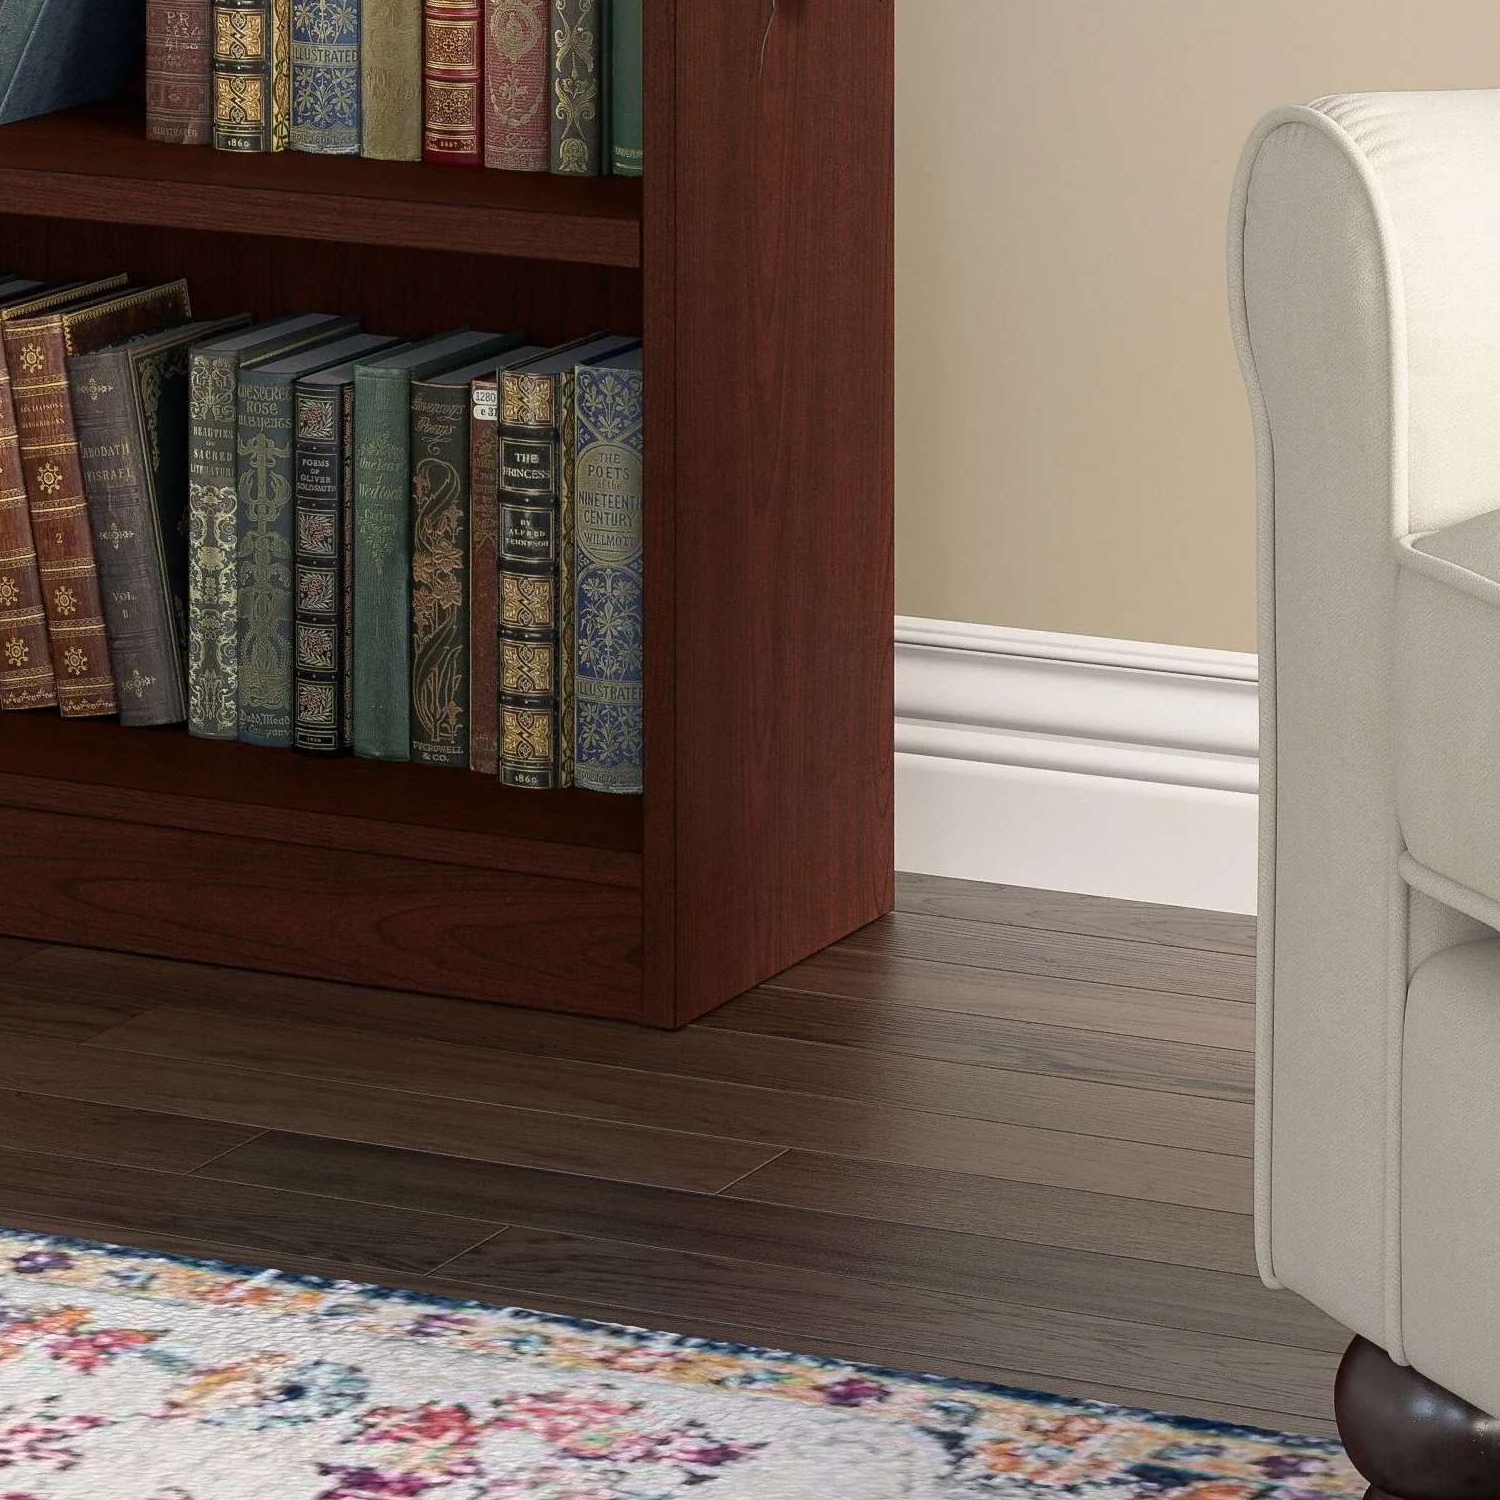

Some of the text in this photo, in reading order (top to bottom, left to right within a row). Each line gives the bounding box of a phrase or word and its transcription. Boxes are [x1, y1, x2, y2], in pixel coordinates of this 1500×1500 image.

[291, 48, 359, 63] ILLUSTRATED
[227, 138, 250, 148] 1860
[475, 390, 496, 402] 1280
[20, 402, 64, 413] LES LIAISONS
[193, 426, 234, 439] BEAUTIES
[83, 443, 130, 458] ABODATH
[193, 448, 233, 462] SACRED
[302, 458, 330, 468] POEMS
[514, 453, 540, 464] THE
[598, 452, 621, 464] THE
[86, 467, 132, 481] YISRAEL
[503, 467, 550, 479] PRINCESS
[588, 464, 630, 480] POETS
[300, 474, 331, 484] OLIVER
[597, 479, 622, 490] of the
[583, 509, 636, 528] CENTURY
[55, 532, 63, 543] 2
[508, 528, 546, 538] ALFRED
[584, 531, 636, 547] WILLMOTT
[505, 538, 549, 547] TENNYSON
[577, 681, 643, 700] ILLUSTRATE
[422, 752, 430, 760] &
[515, 773, 537, 784] 1860
